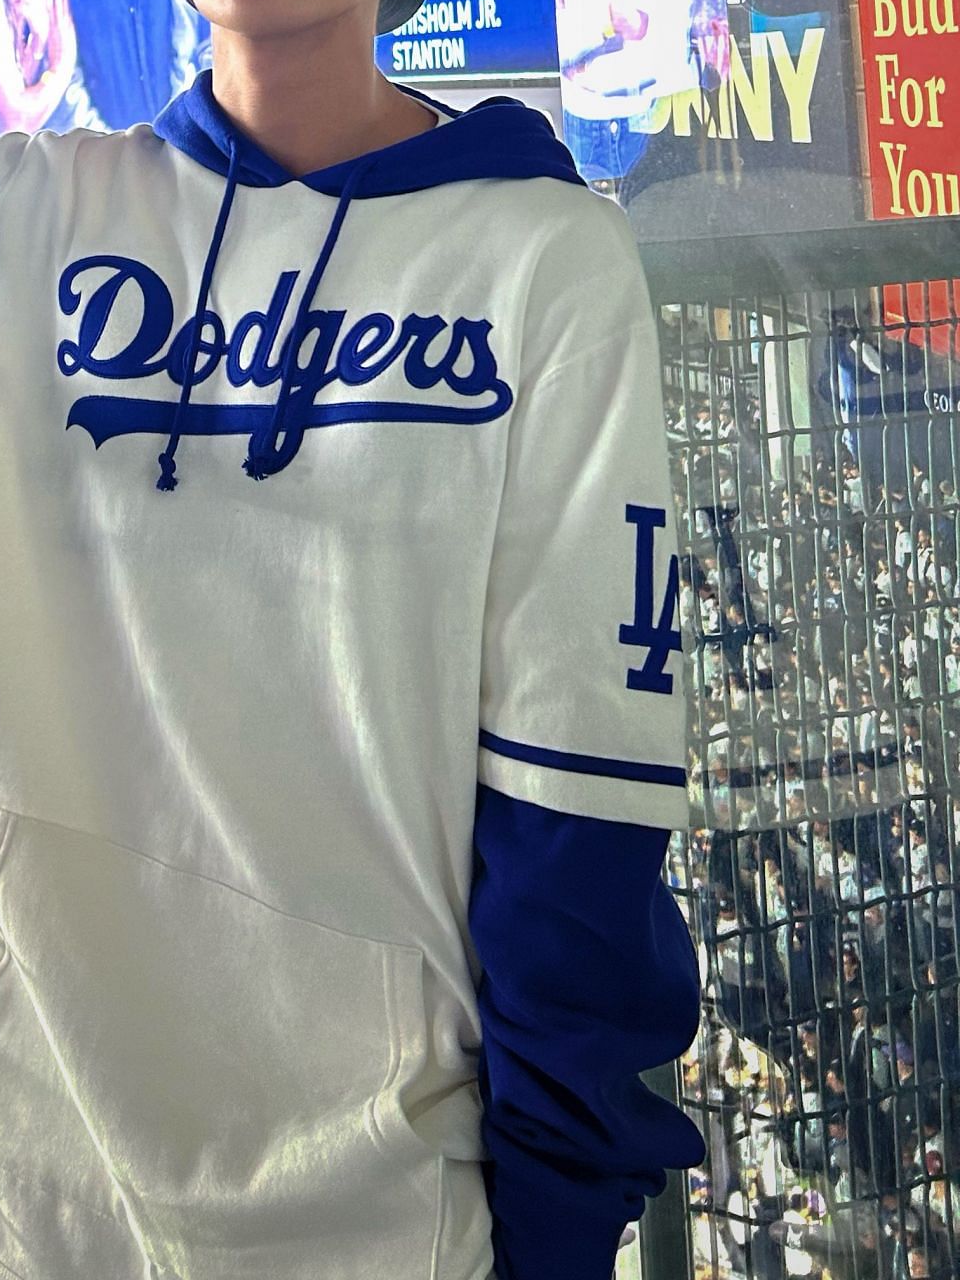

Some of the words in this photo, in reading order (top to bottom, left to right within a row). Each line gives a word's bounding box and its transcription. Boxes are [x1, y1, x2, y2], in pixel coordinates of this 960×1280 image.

[392, 37, 466, 71] STANTON
[875, 54, 945, 128] For
[58, 255, 513, 475] Dodgers
